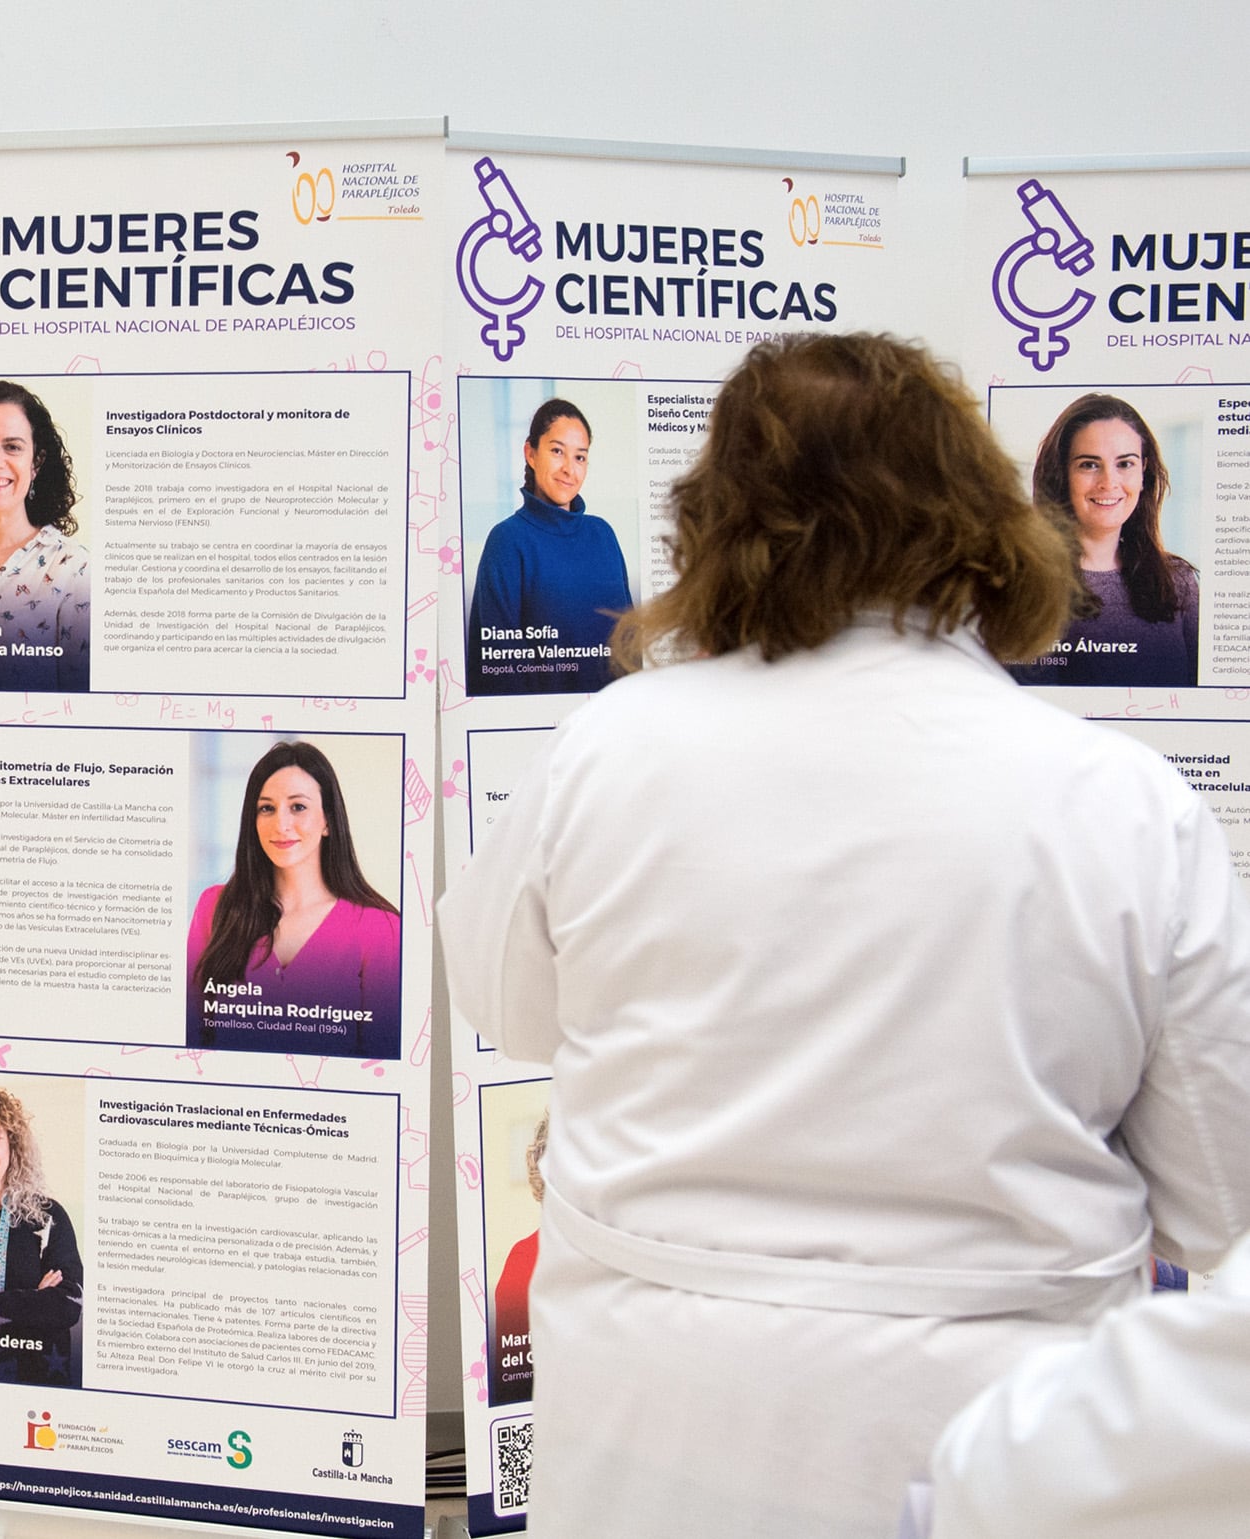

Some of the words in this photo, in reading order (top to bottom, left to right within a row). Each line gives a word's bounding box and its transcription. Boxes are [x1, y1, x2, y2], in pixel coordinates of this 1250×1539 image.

[342, 163, 397, 173] HOSPITAL
[341, 175, 399, 188] NACIONAL
[403, 175, 418, 185] DE
[341, 186, 420, 200] PARAPLÉJICOS
[387, 204, 420, 214] Toledo
[1, 210, 260, 256] MUJERES
[555, 221, 764, 268] MUJERES
[0, 256, 355, 310] CIENTÍFICAS
[555, 267, 838, 322] CIENTÍFICAS
[34, 320, 111, 334] HOSPITAL
[115, 319, 201, 333] NACIONAL
[205, 318, 227, 332] DE
[232, 315, 355, 331] PARAPLÉJICOS
[1107, 334, 1138, 347] DEL
[1142, 333, 1224, 347] HOSPITAL
[647, 394, 705, 405] Especialista
[106, 410, 186, 422] Investigadora
[188, 409, 264, 420] Postdoctoral
[266, 411, 274, 422] y
[276, 408, 332, 419] monitora
[334, 408, 350, 419] de
[647, 408, 681, 418] Diseño
[106, 425, 154, 436] Ensayos
[155, 424, 202, 434] Clínicos
[648, 422, 688, 432] Médicos
[689, 423, 696, 434] y
[480, 626, 523, 640] Diana
[11, 643, 64, 656] Manso
[481, 647, 535, 660] Herrera
[537, 644, 612, 658] Valenzuela
[1074, 637, 1137, 653] Álvarez
[1037, 656, 1068, 666] (1985)
[481, 664, 515, 675] Bogotá,
[516, 663, 554, 673] Colombia
[555, 662, 579, 672] (1995)
[55, 762, 70, 772] de
[73, 762, 105, 775] Flujo,
[108, 764, 173, 775] Separación
[8, 775, 90, 787] Extracelulares
[203, 977, 262, 998] Ángela
[204, 1000, 283, 1017] Marquina
[287, 1004, 373, 1023] Rodríguez
[202, 1017, 255, 1029] Tomelloso,
[256, 1020, 292, 1031] Ciudad
[294, 1022, 316, 1032] Real
[318, 1023, 347, 1035] (1994)
[99, 1099, 174, 1113] Investigación
[175, 1103, 243, 1117] Traslacional
[245, 1109, 260, 1118] en
[262, 1109, 347, 1123] Enfermedades
[99, 1113, 194, 1128] Cardiovasculares
[196, 1120, 251, 1131] mediante
[252, 1122, 349, 1138] Técnicas-Ómicas
[501, 1352, 523, 1368] del
[57, 1423, 96, 1432] FUNDACIÓN
[55, 1433, 89, 1442] HOSPITAL
[90, 1436, 124, 1445] NACIONAL
[167, 1438, 221, 1453] sescam
[64, 1444, 114, 1454] PARAPLÉJICOS
[312, 1467, 357, 1481] Castilla-La
[360, 1472, 393, 1485] Mancha
